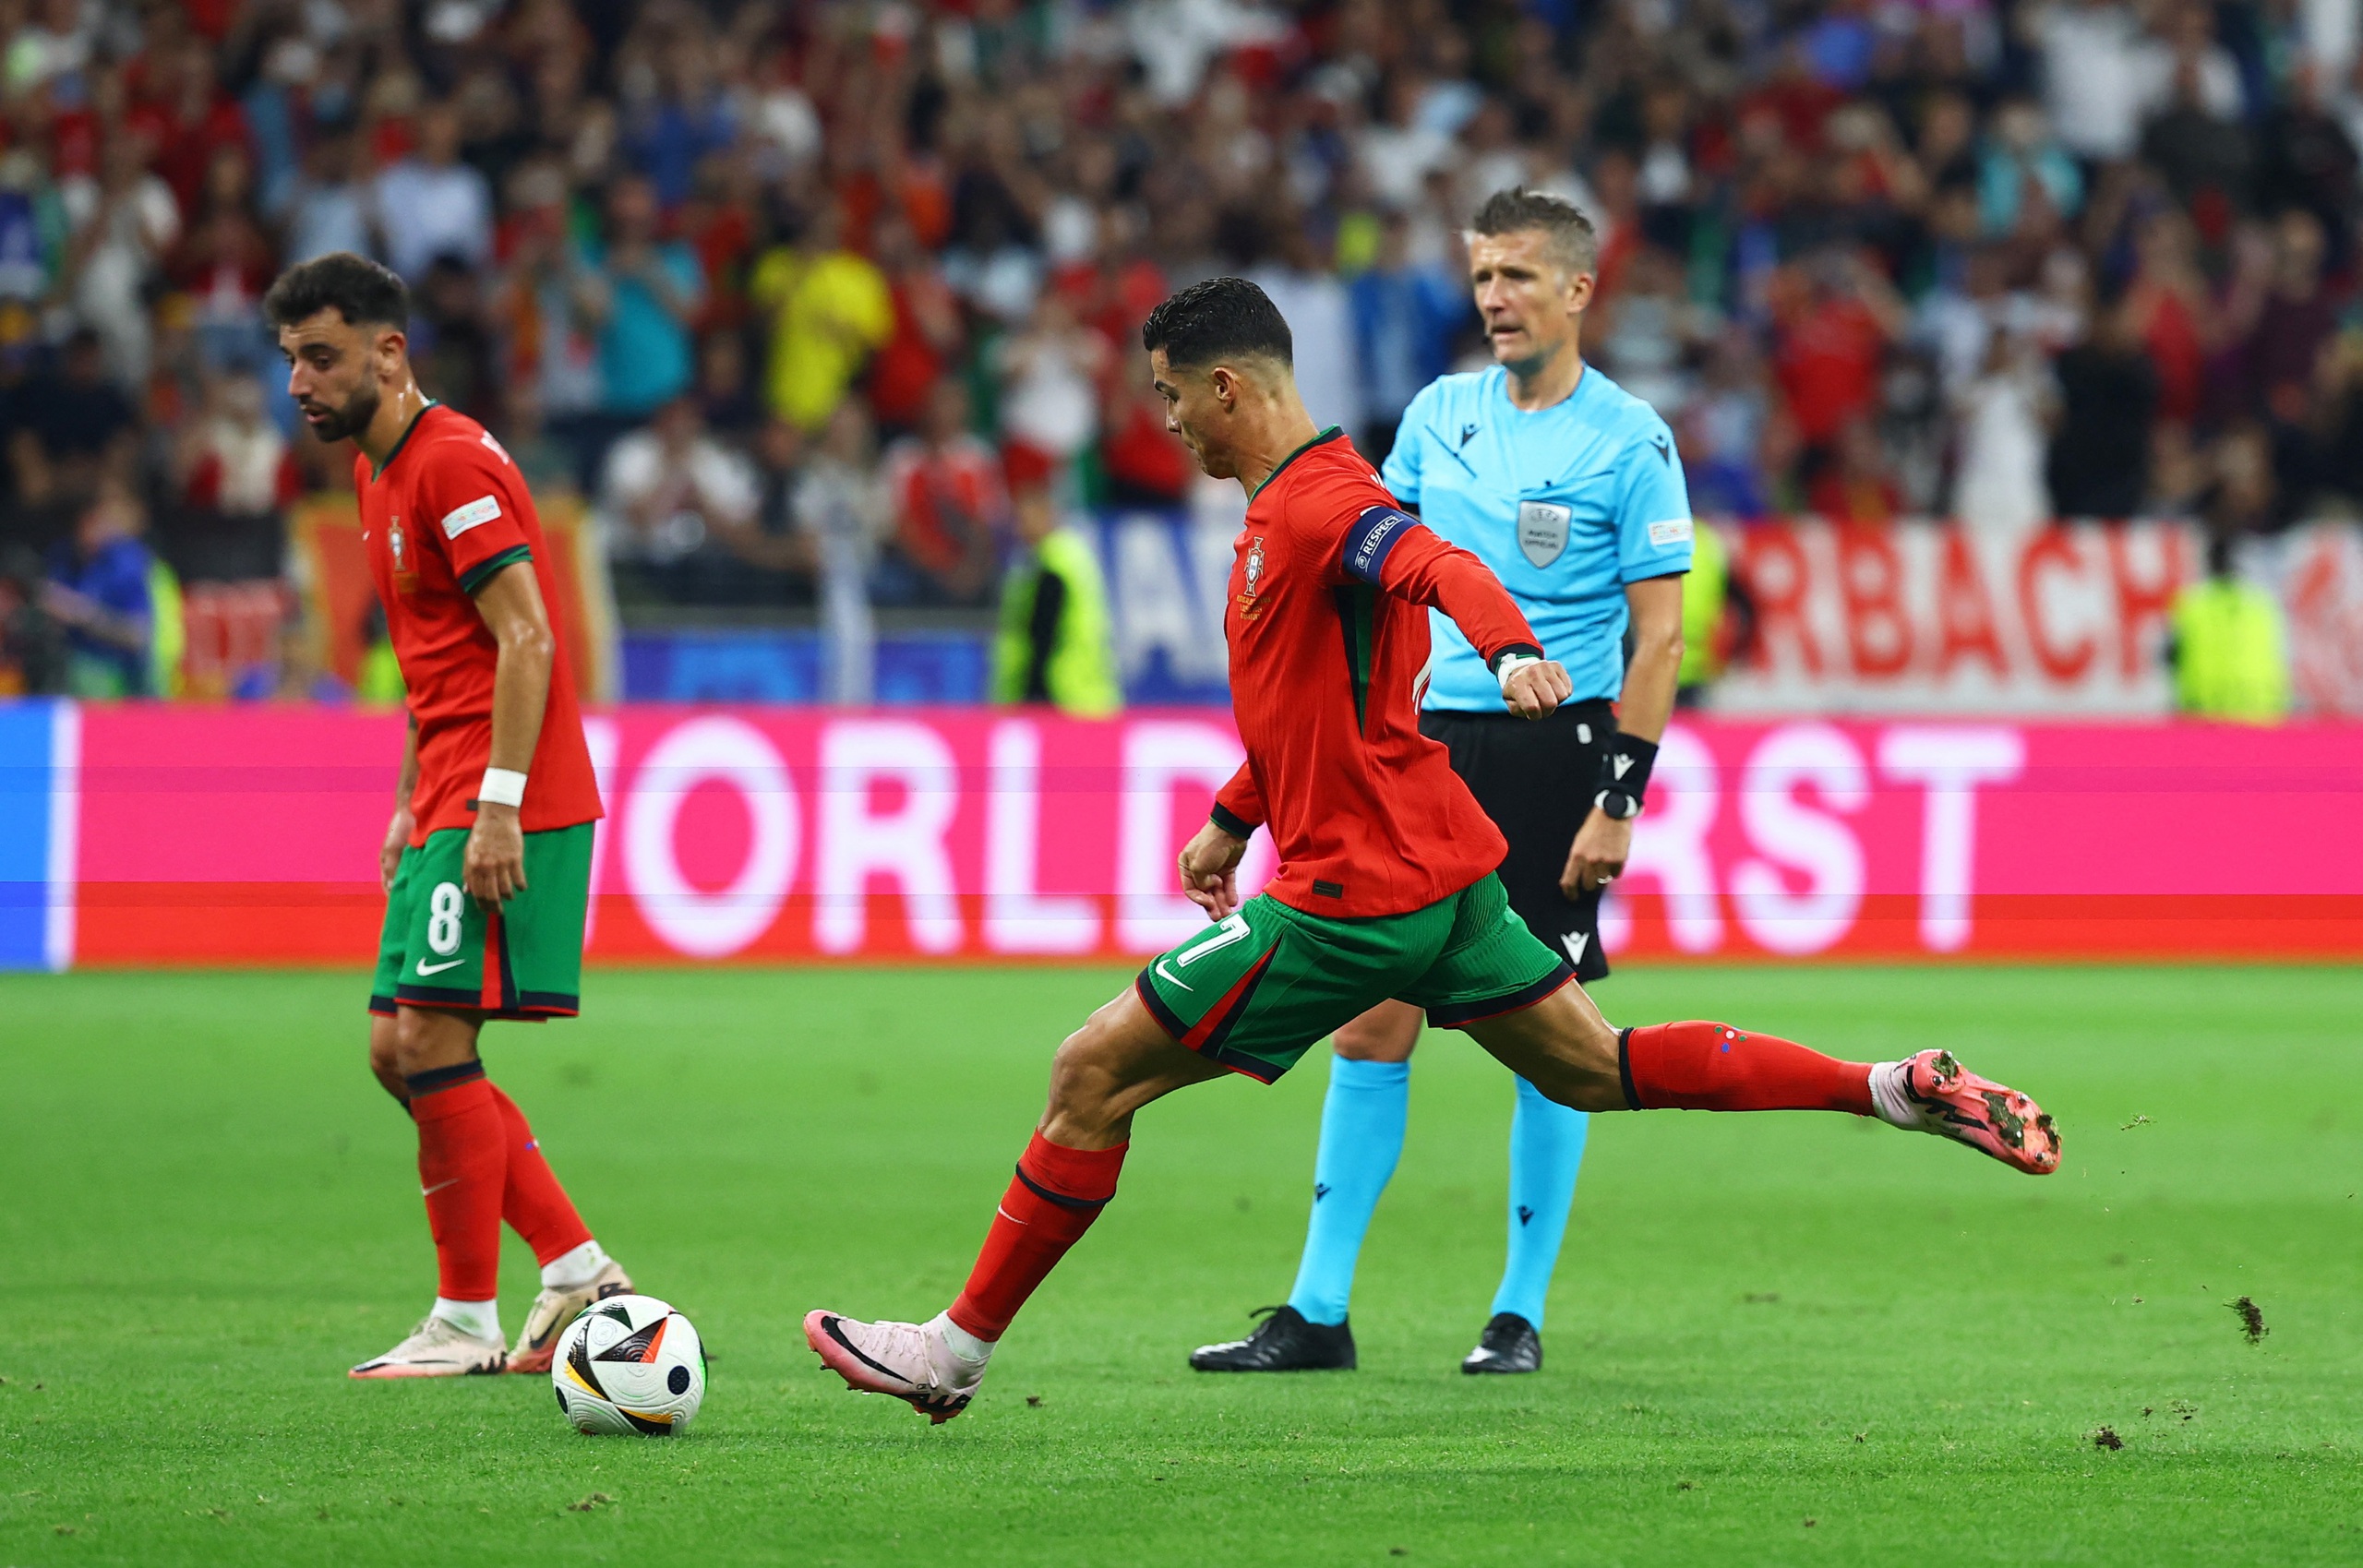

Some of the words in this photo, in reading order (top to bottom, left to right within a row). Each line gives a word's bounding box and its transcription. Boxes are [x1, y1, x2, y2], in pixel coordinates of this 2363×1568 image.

[1362, 515, 1399, 555] RESPECT
[1741, 521, 2189, 685] RBACH
[583, 716, 1285, 957] ORLD
[1600, 722, 2027, 956] RST
[427, 881, 464, 956] 8
[1176, 913, 1251, 968] 7
